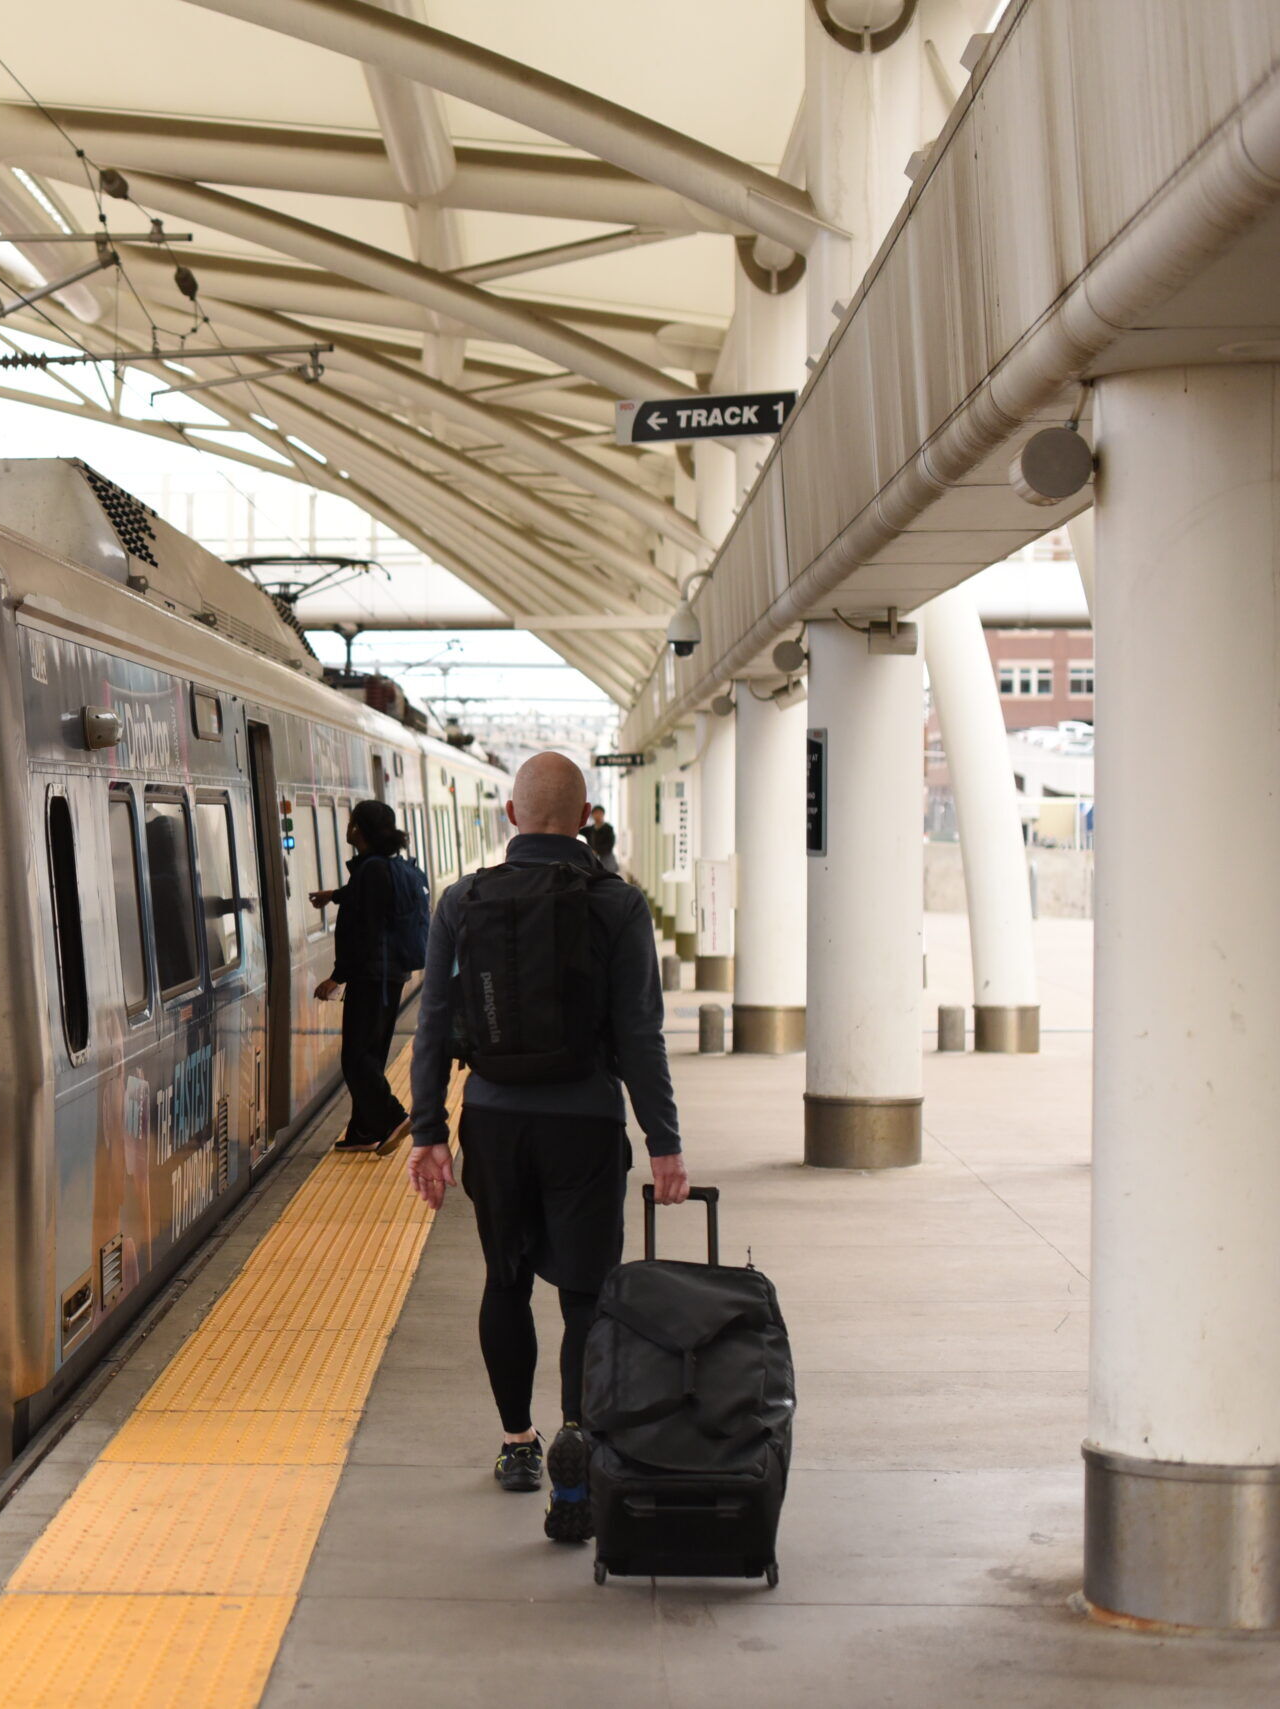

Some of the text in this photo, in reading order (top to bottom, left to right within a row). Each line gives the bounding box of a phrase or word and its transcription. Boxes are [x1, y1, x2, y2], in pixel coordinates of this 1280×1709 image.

[676, 401, 785, 428] TRACK 1
[480, 971, 501, 1044] patagonia
[157, 1084, 173, 1166] THE
[173, 1043, 212, 1152] FASTEST
[172, 1135, 215, 1243] TO HYDRATE
